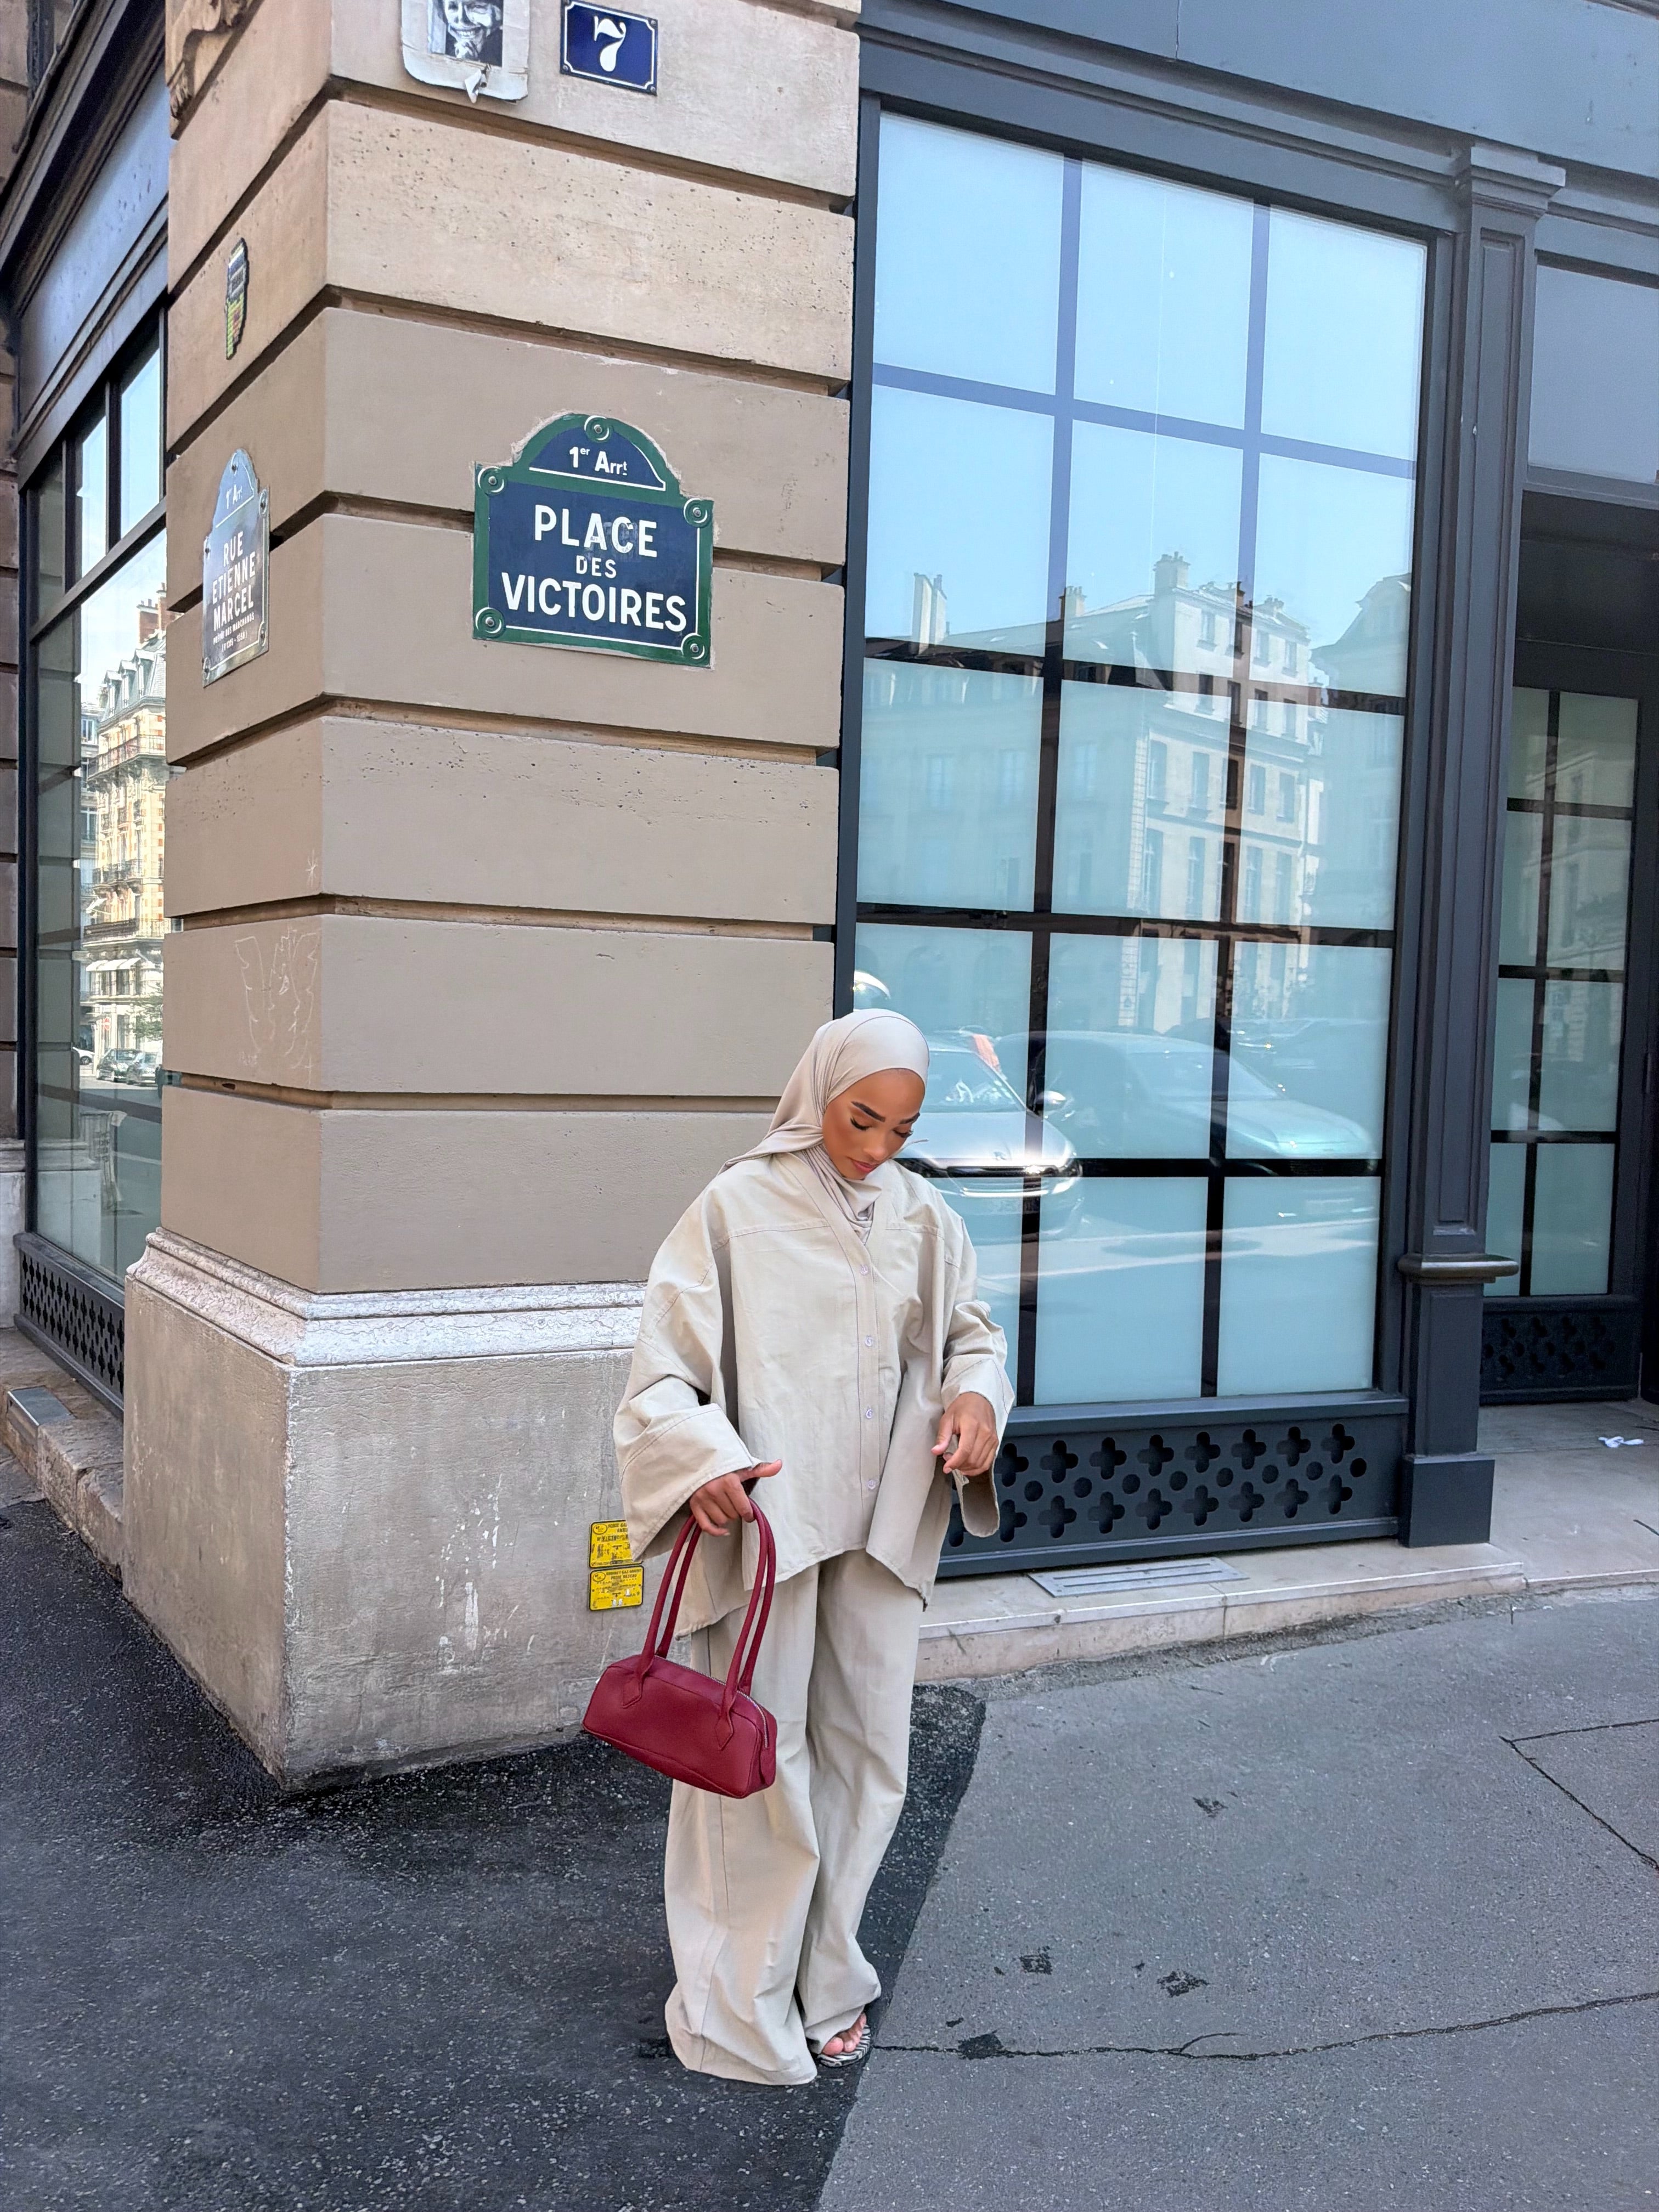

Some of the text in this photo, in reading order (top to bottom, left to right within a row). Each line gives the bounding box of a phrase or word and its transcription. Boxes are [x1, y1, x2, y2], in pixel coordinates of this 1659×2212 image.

[593, 15, 627, 72] 7
[569, 446, 628, 476] 1er Arrt
[223, 531, 244, 567] RUE
[534, 504, 658, 558] PLACE
[212, 551, 256, 605] ETIENNE
[575, 555, 617, 579] DES
[213, 584, 254, 632] MARCEL
[501, 571, 687, 633] VICTOIRES
